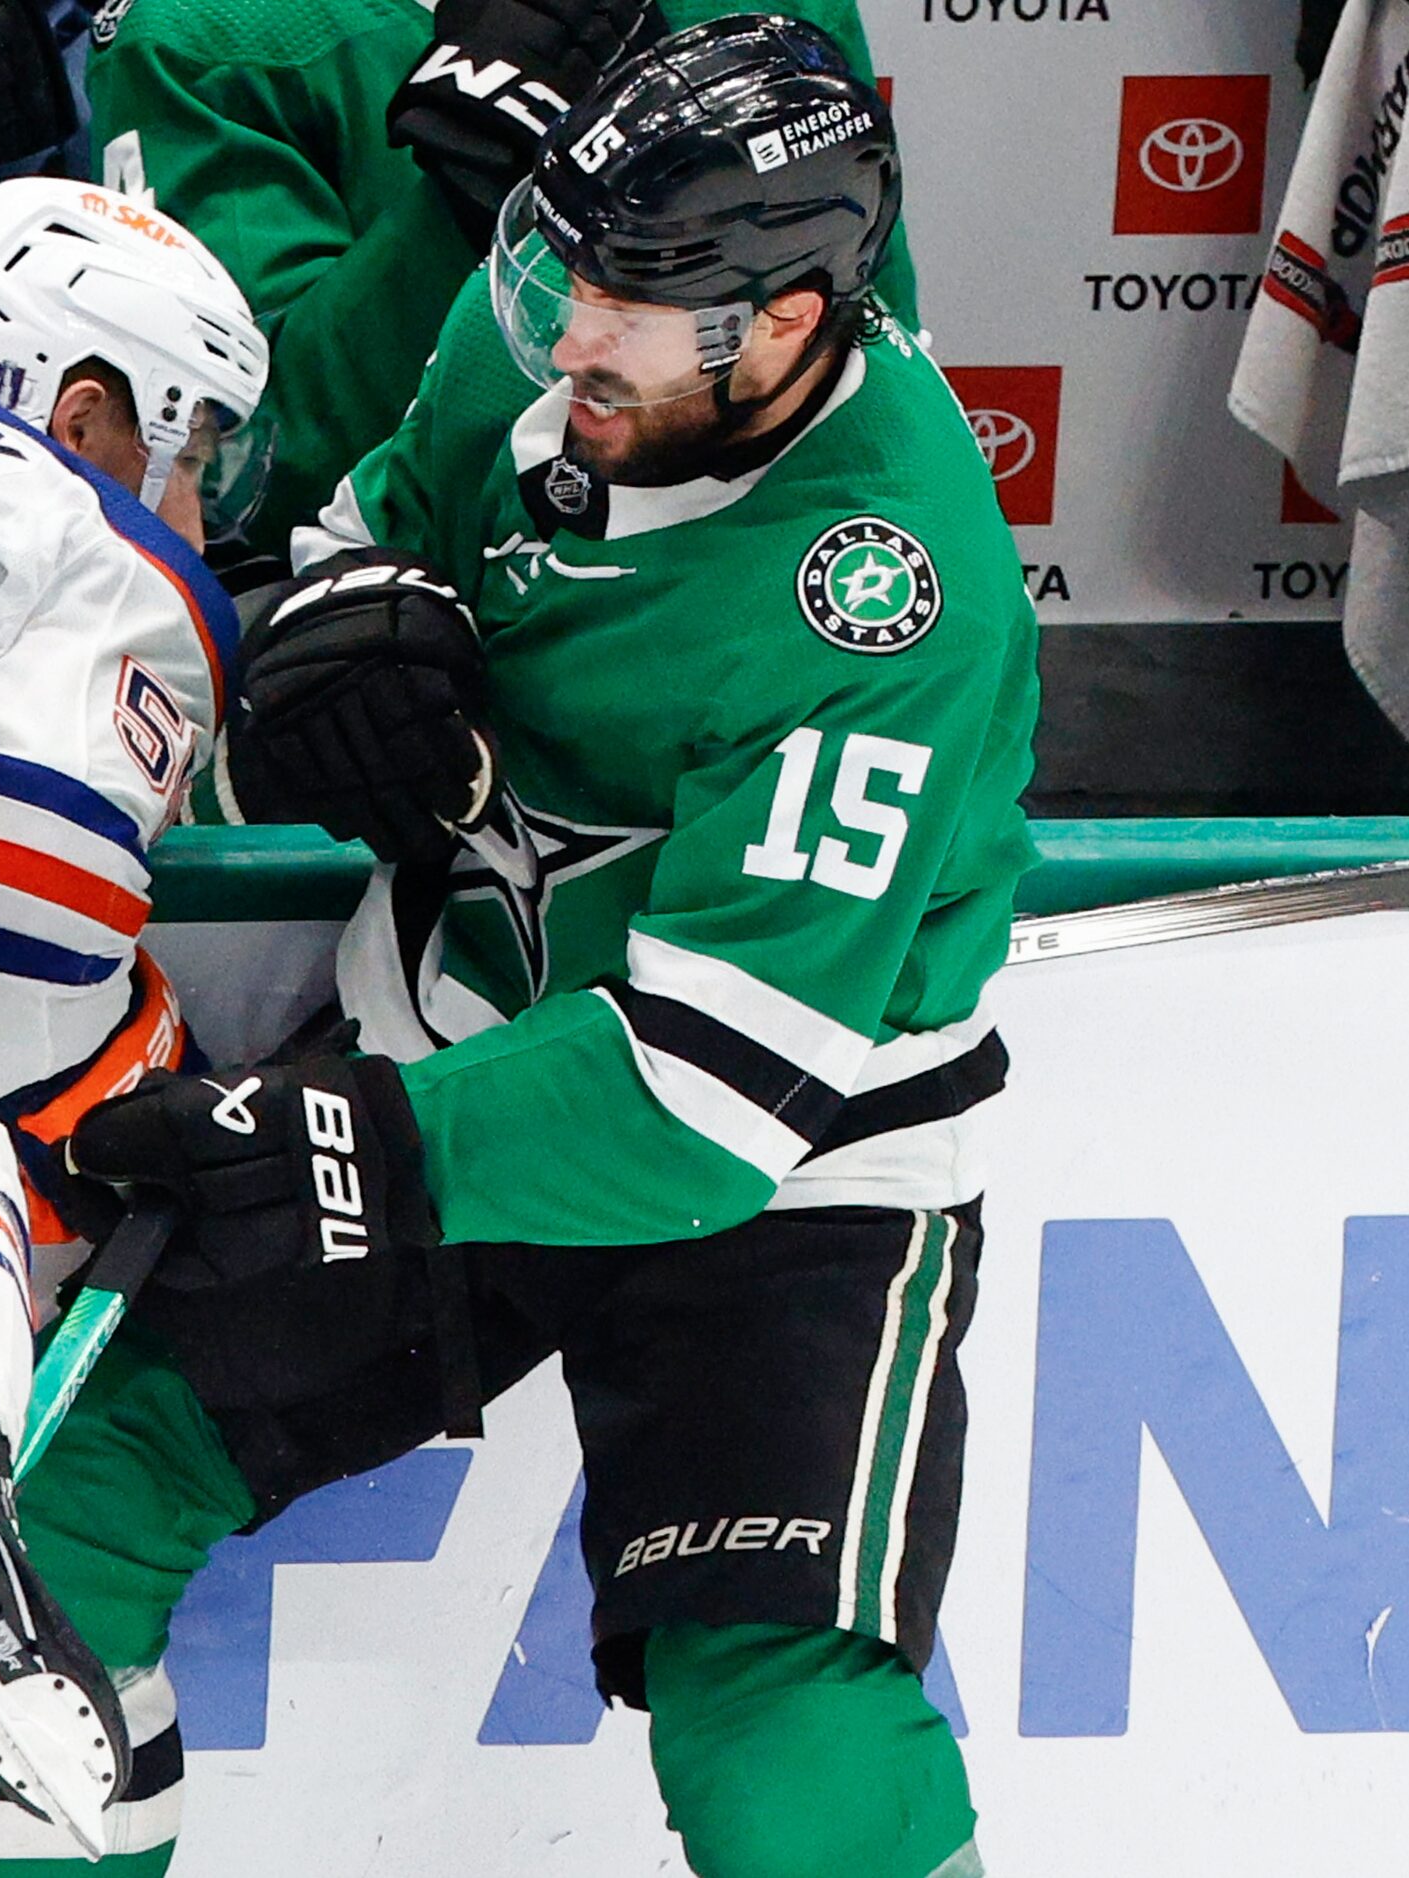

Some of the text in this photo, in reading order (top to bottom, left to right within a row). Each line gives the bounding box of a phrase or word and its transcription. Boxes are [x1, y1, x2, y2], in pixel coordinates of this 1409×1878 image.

[568, 111, 626, 174] 15
[782, 100, 852, 141] ENERGY
[788, 111, 874, 160] TRANSFER
[807, 526, 923, 586] DALLAS
[824, 598, 931, 644] STARS
[742, 727, 933, 900] 15
[613, 1516, 831, 1578] BAUER
